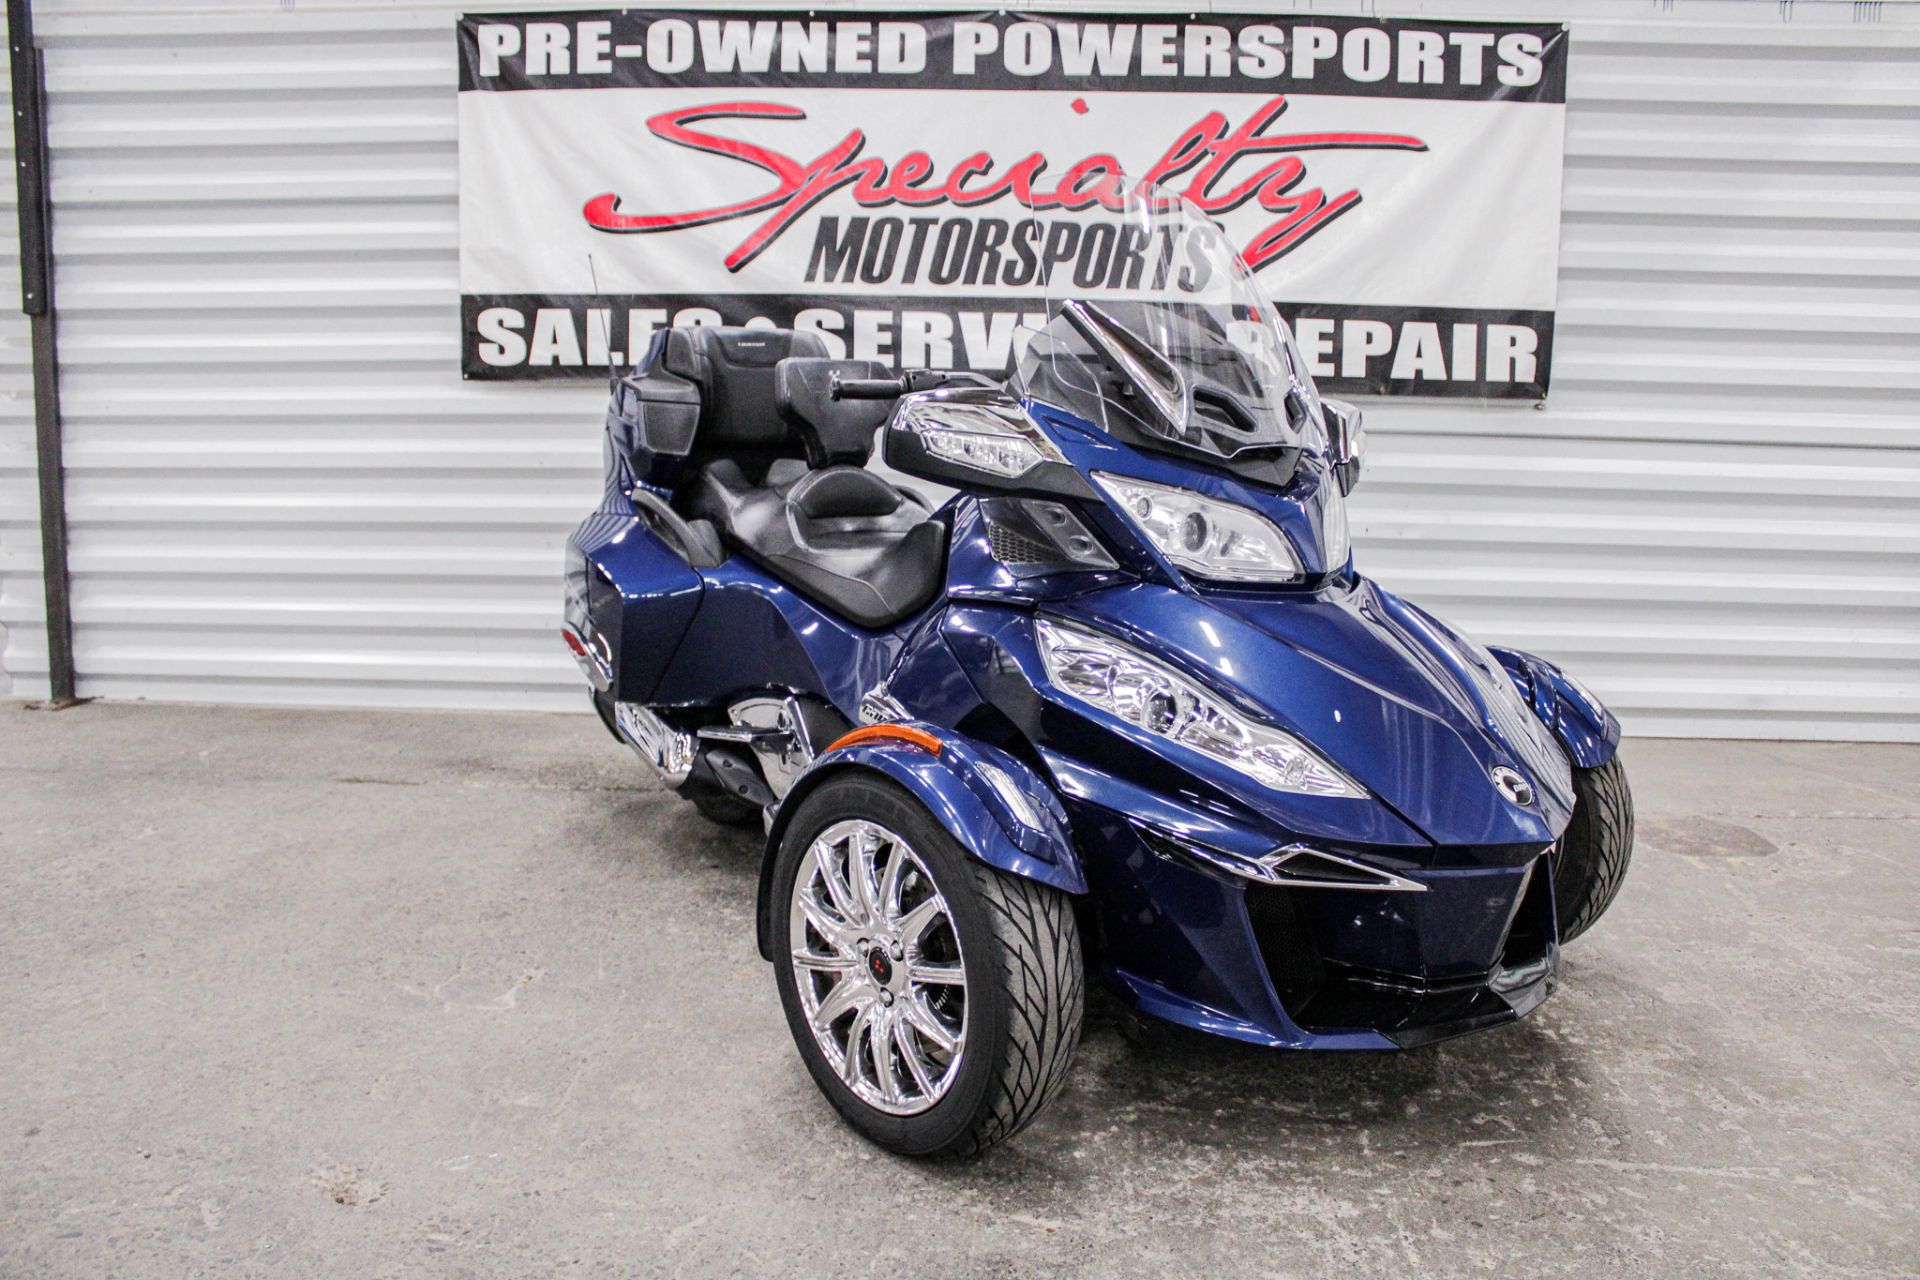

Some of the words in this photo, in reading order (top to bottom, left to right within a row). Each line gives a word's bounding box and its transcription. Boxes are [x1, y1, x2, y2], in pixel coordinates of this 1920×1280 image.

[477, 19, 928, 77] PRE-OWNED
[952, 23, 1544, 87] POWERSPORTS
[583, 95, 1430, 274] Specialty
[804, 215, 1225, 293] MOTORSPORTS
